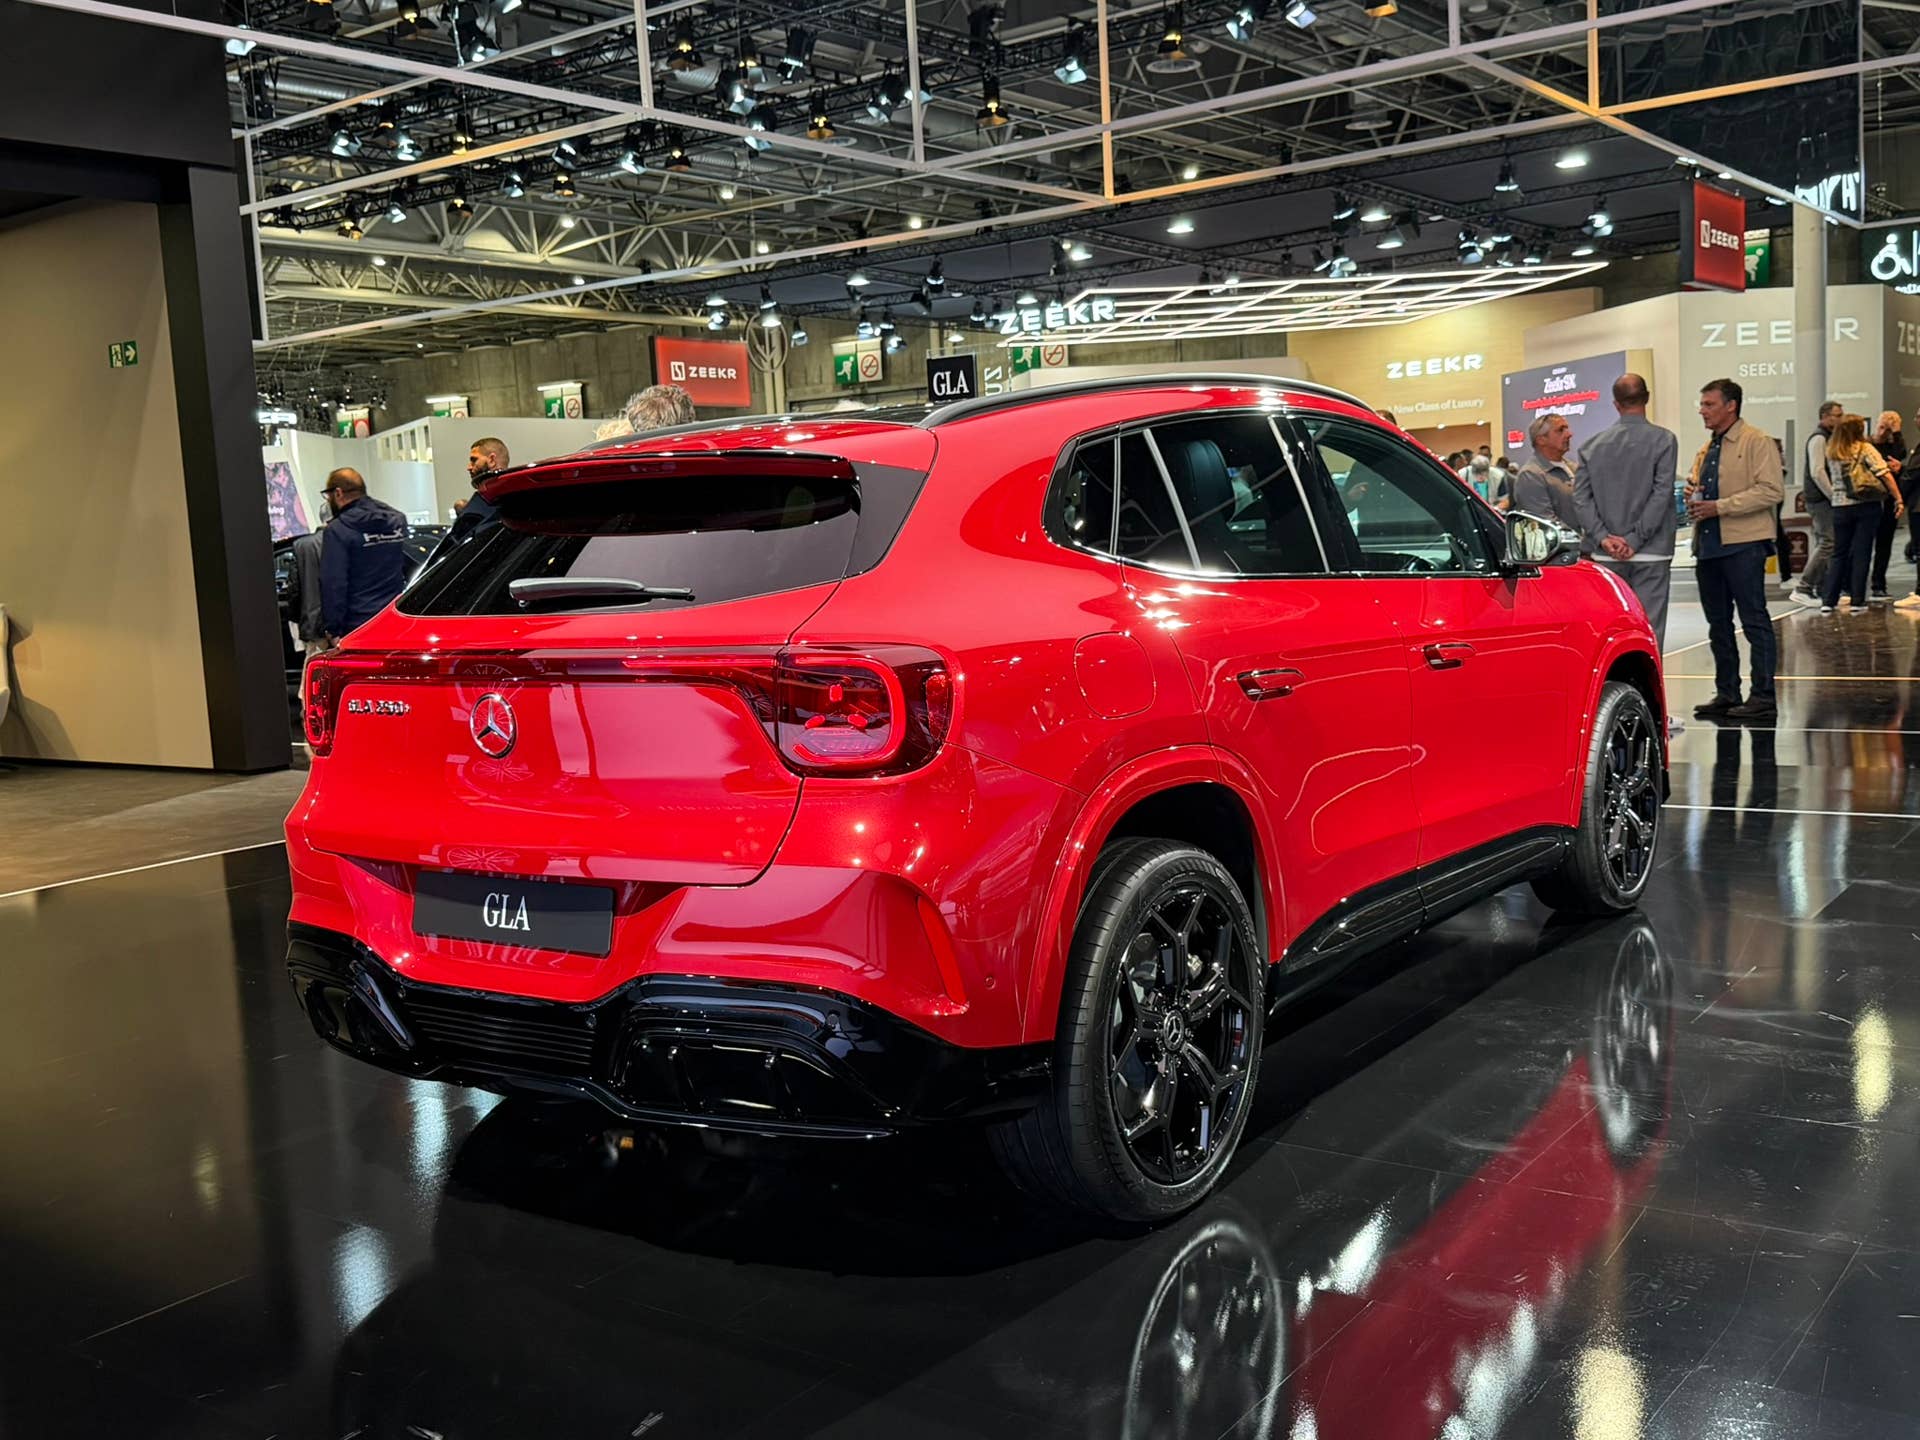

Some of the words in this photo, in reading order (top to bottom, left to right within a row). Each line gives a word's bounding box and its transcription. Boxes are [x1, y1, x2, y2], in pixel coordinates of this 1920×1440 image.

[1711, 228, 1740, 250] ZEEKR
[999, 299, 1116, 335] ZEEKR
[1702, 317, 1861, 348] ZEER
[688, 366, 737, 379] ZEEKR
[1386, 354, 1482, 380] ZEEKR
[1738, 362, 1778, 378] SEEK
[933, 369, 970, 397] GLA
[1441, 400, 1451, 411] of
[348, 699, 374, 714] GLA
[483, 892, 531, 931] GLA
